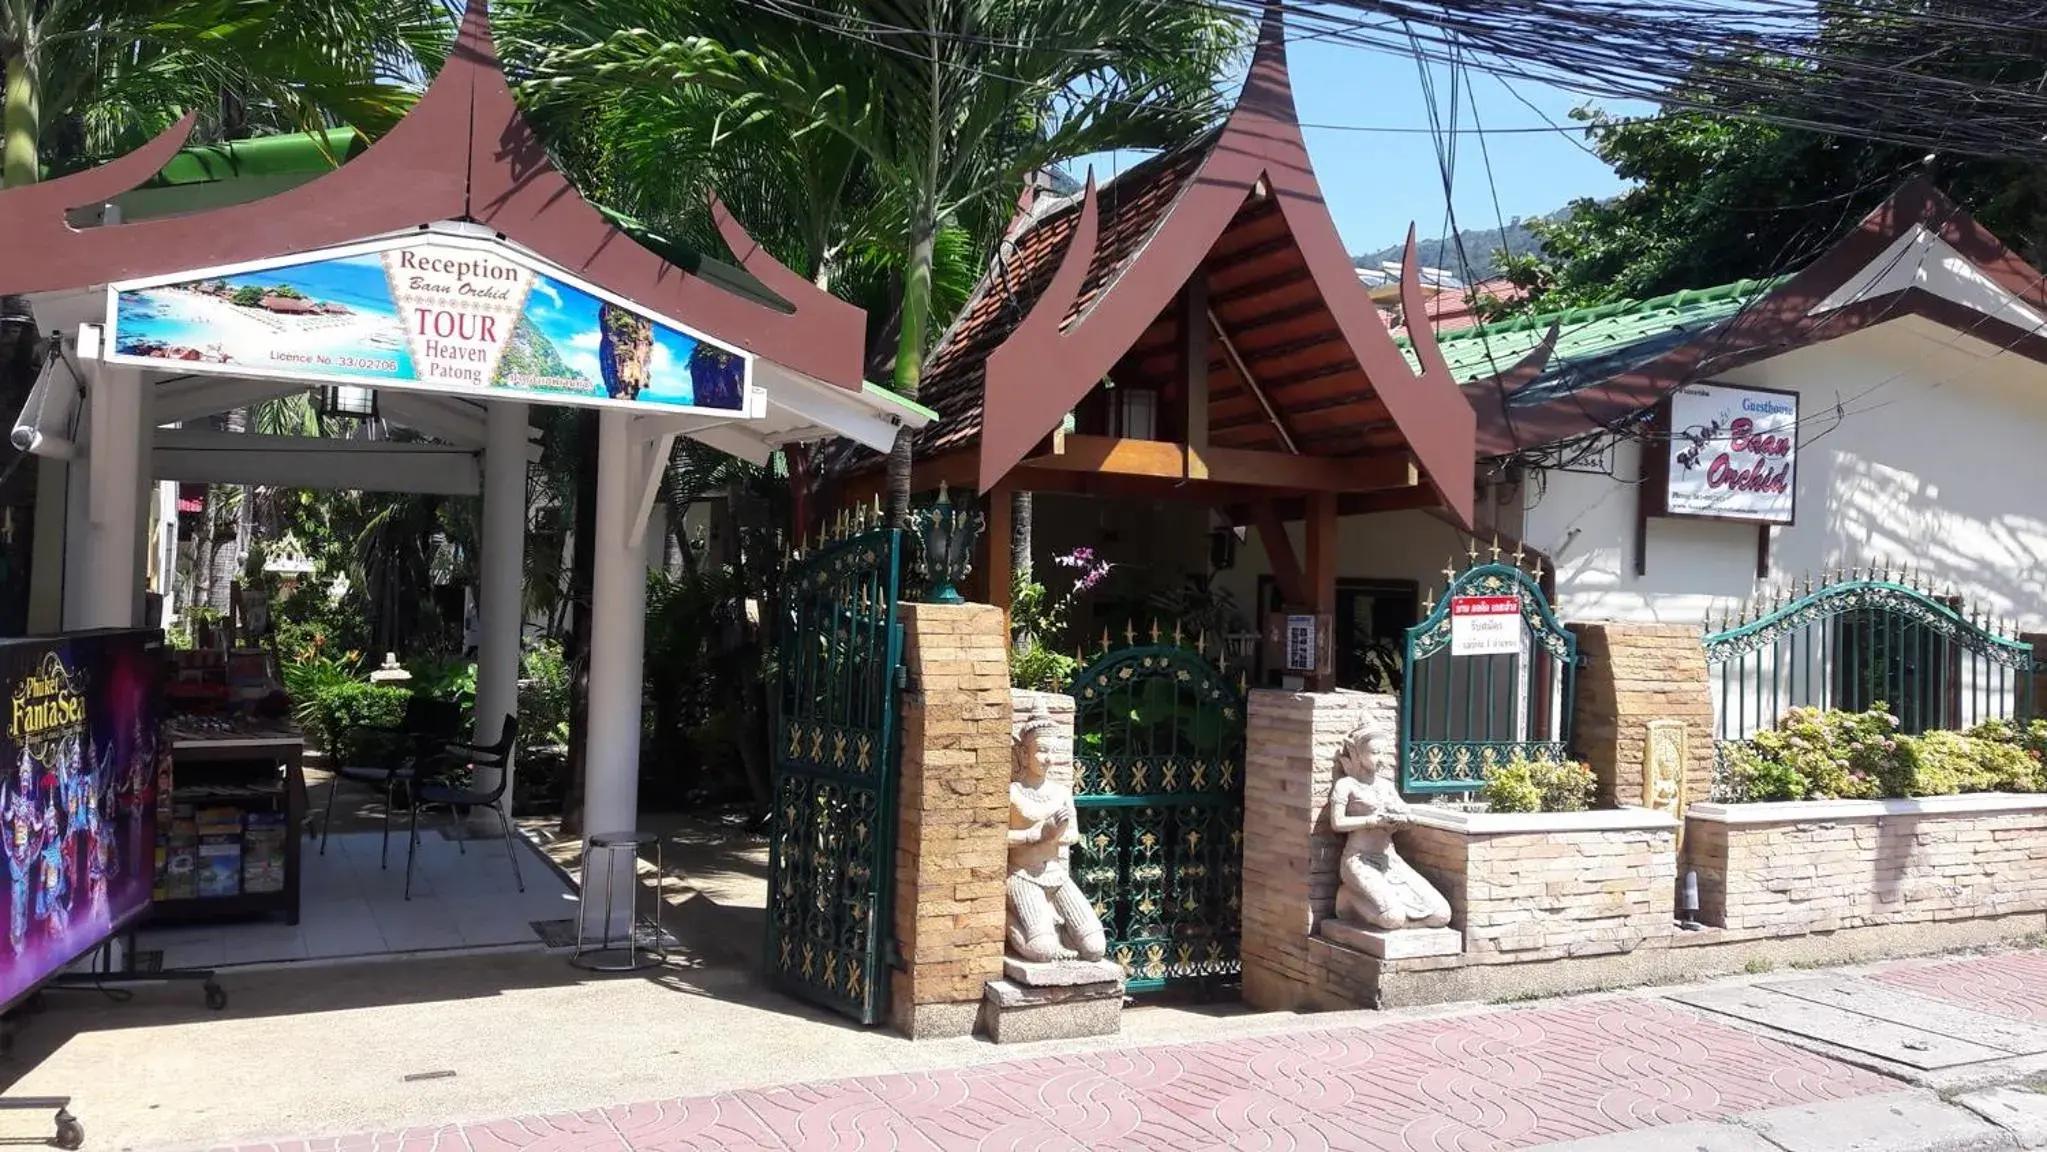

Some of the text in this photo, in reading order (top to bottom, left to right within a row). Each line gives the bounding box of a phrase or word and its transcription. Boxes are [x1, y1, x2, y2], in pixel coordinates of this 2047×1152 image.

[400, 250, 518, 282] Reception
[409, 276, 511, 300] Baan Orchid
[414, 308, 497, 343] TOUR
[270, 350, 313, 363] Licence
[425, 339, 487, 362] Heaven
[430, 362, 482, 386] Patong
[1742, 397, 1794, 416] Guesthouse
[1730, 417, 1791, 456] Baan
[1706, 453, 1790, 494] Orchid
[26, 676, 59, 699] Phuket
[12, 689, 86, 736] FantaSea
